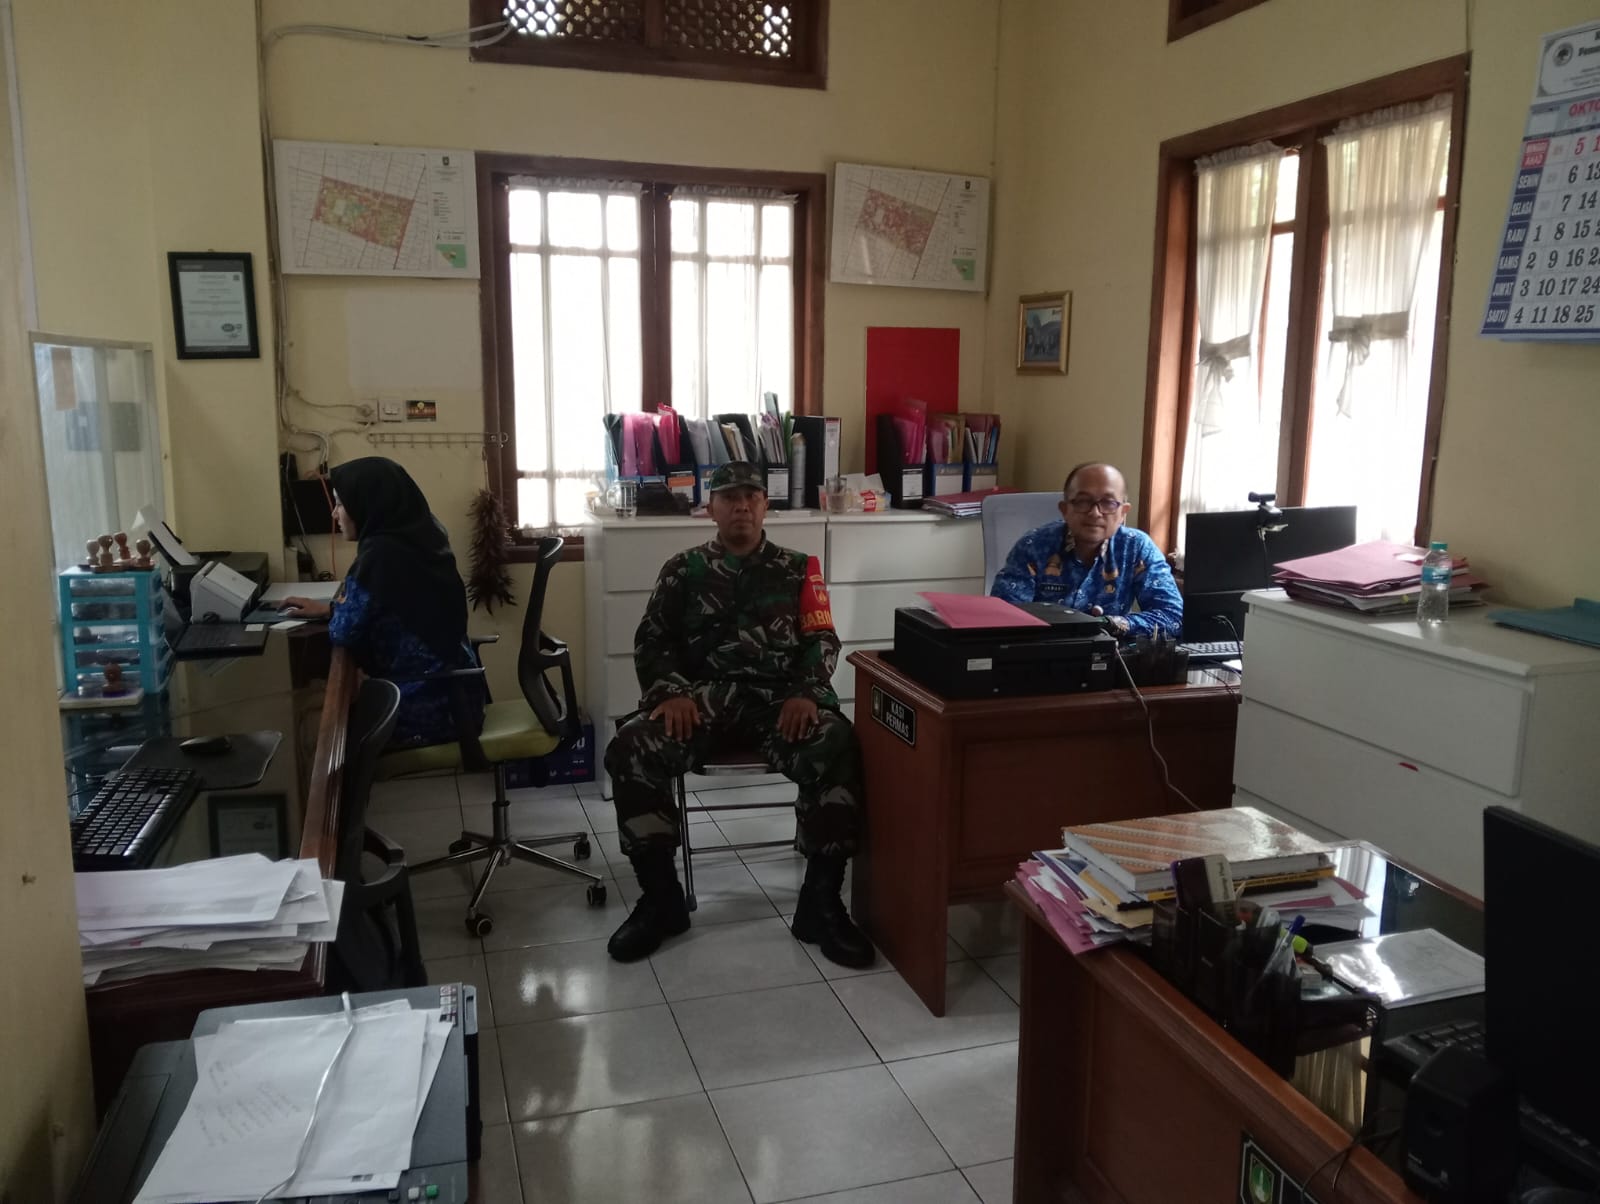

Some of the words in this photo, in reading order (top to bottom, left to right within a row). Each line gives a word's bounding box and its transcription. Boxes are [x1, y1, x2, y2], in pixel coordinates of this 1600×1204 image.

[1574, 137, 1586, 155] 5
[1568, 165, 1578, 183] 6
[1562, 194, 1572, 211] 7
[1578, 190, 1598, 209] 14
[1506, 228, 1526, 243] RABU
[1533, 225, 1542, 241] 1
[1554, 222, 1565, 240] 8
[1572, 220, 1591, 238] 15
[1499, 255, 1520, 269] KAMIS
[1526, 252, 1536, 269] 2
[1548, 250, 1558, 268] 9
[1566, 248, 1585, 267] 16
[1520, 280, 1530, 296] 3
[1537, 278, 1555, 296] 10
[1559, 277, 1579, 295] 17
[1581, 276, 1600, 294] 24
[1486, 309, 1508, 323] SABTU
[1514, 306, 1524, 323] 4
[1530, 306, 1548, 323] 11
[1552, 305, 1571, 323] 18
[1574, 305, 1595, 323] 25
